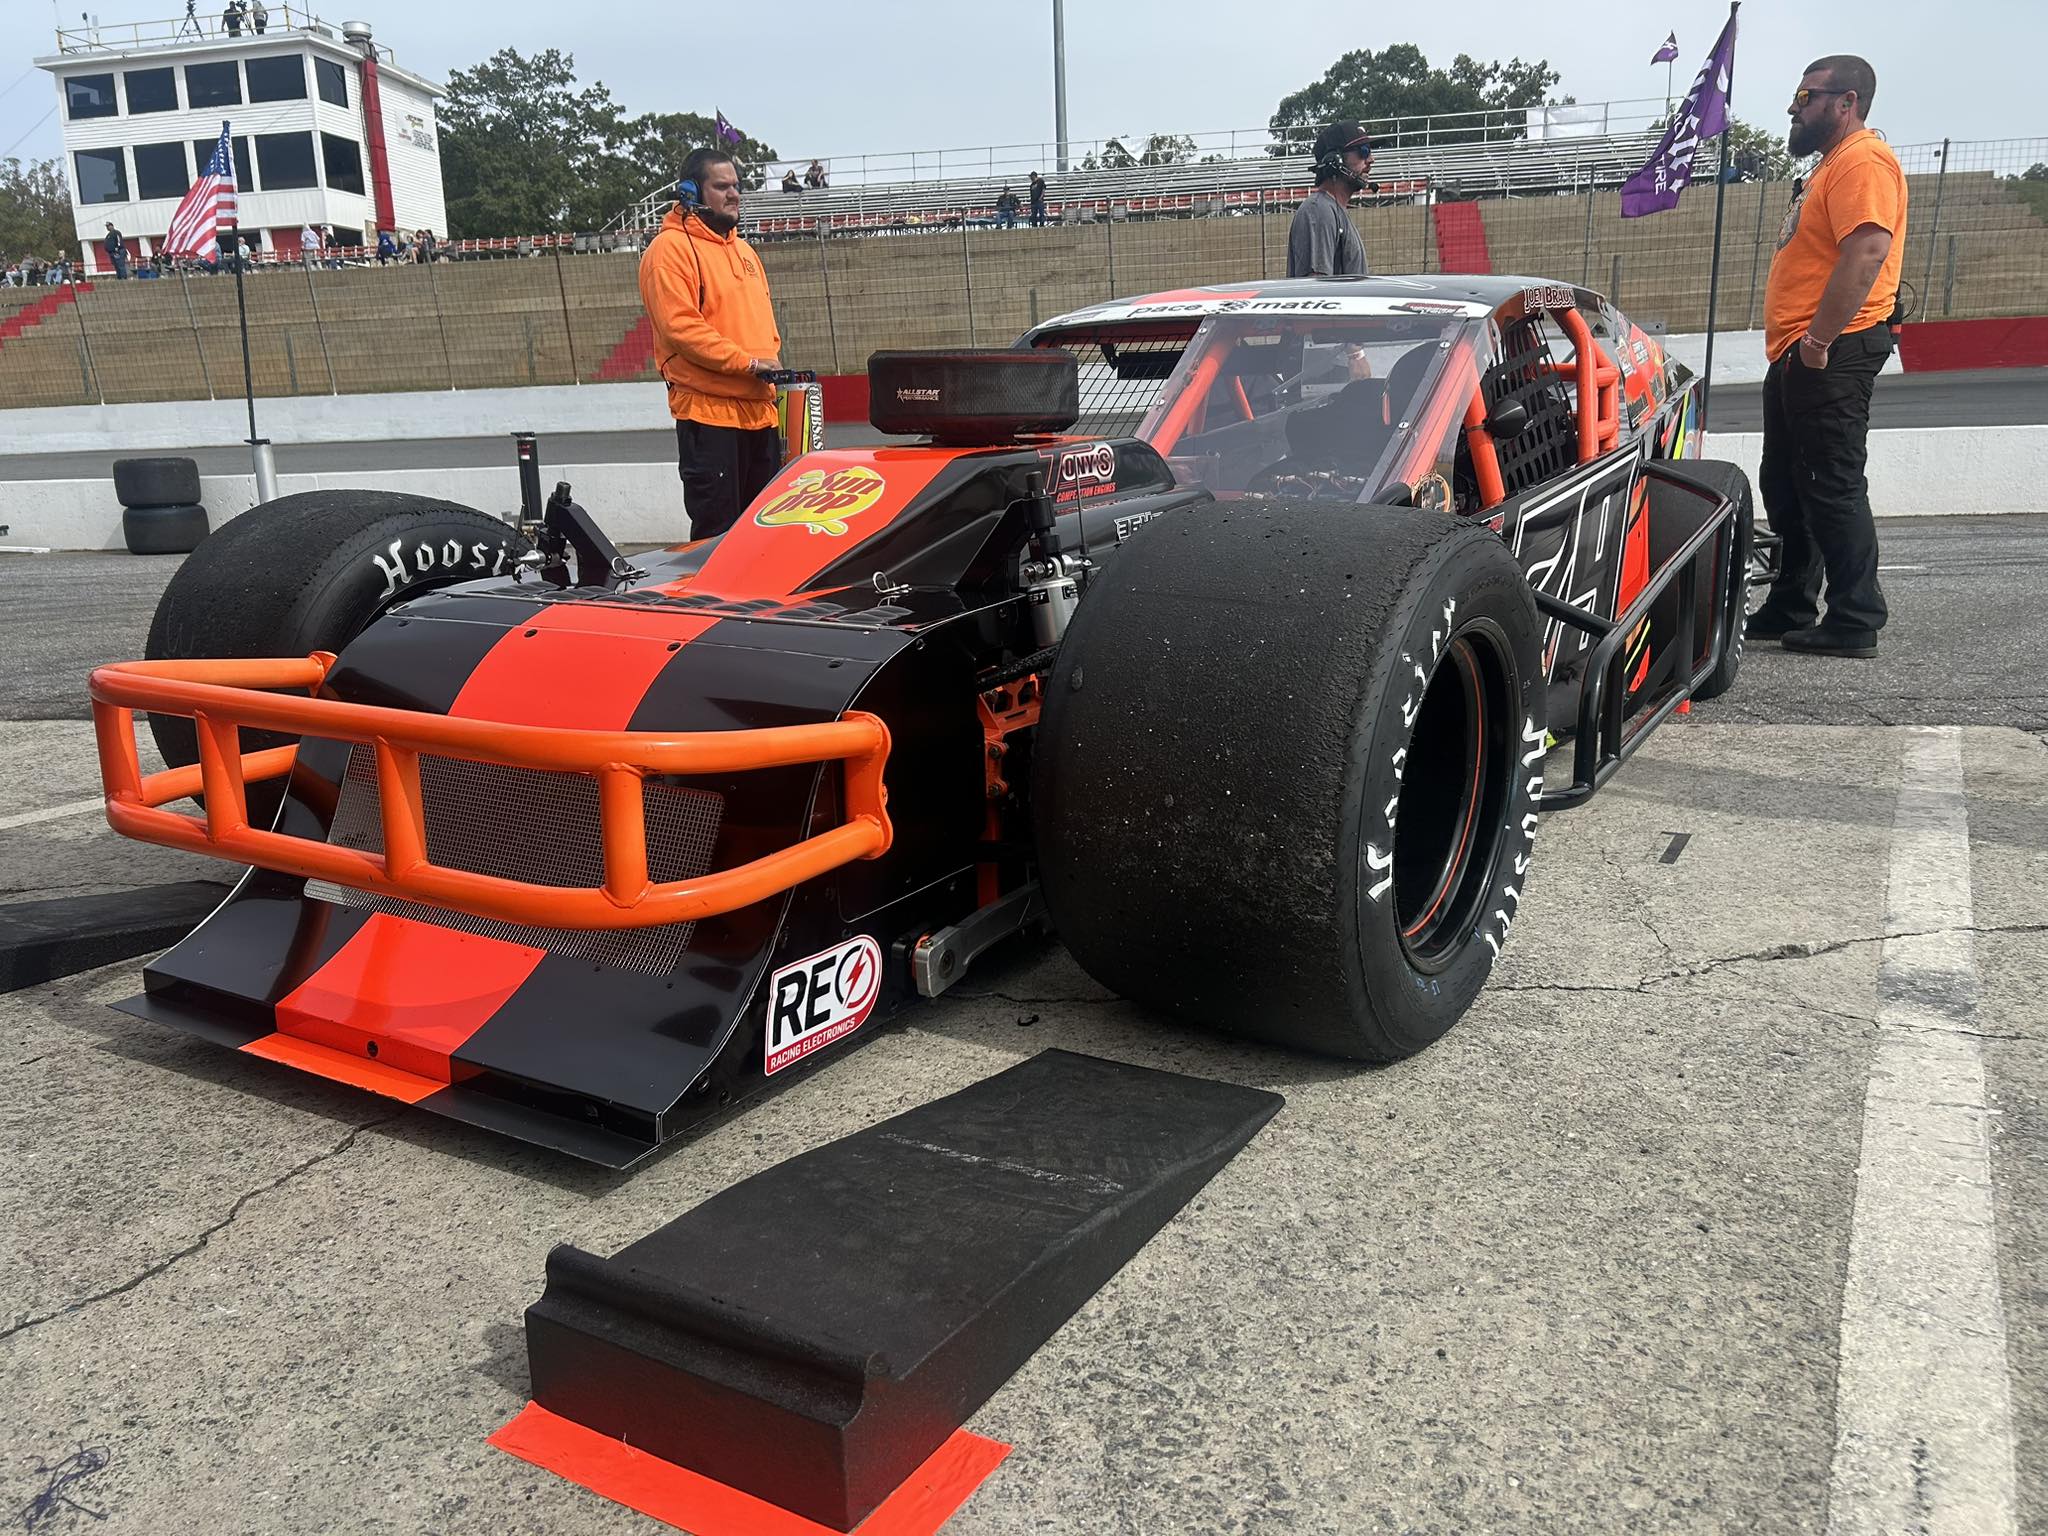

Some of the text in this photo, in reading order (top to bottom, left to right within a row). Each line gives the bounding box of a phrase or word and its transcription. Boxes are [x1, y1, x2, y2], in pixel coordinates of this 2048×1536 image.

[1126, 299, 1342, 318] pace matic
[800, 469, 884, 496] Sun
[1093, 481, 1117, 497] ENGINES
[770, 1017, 856, 1070] RACING ELECTRONICS
